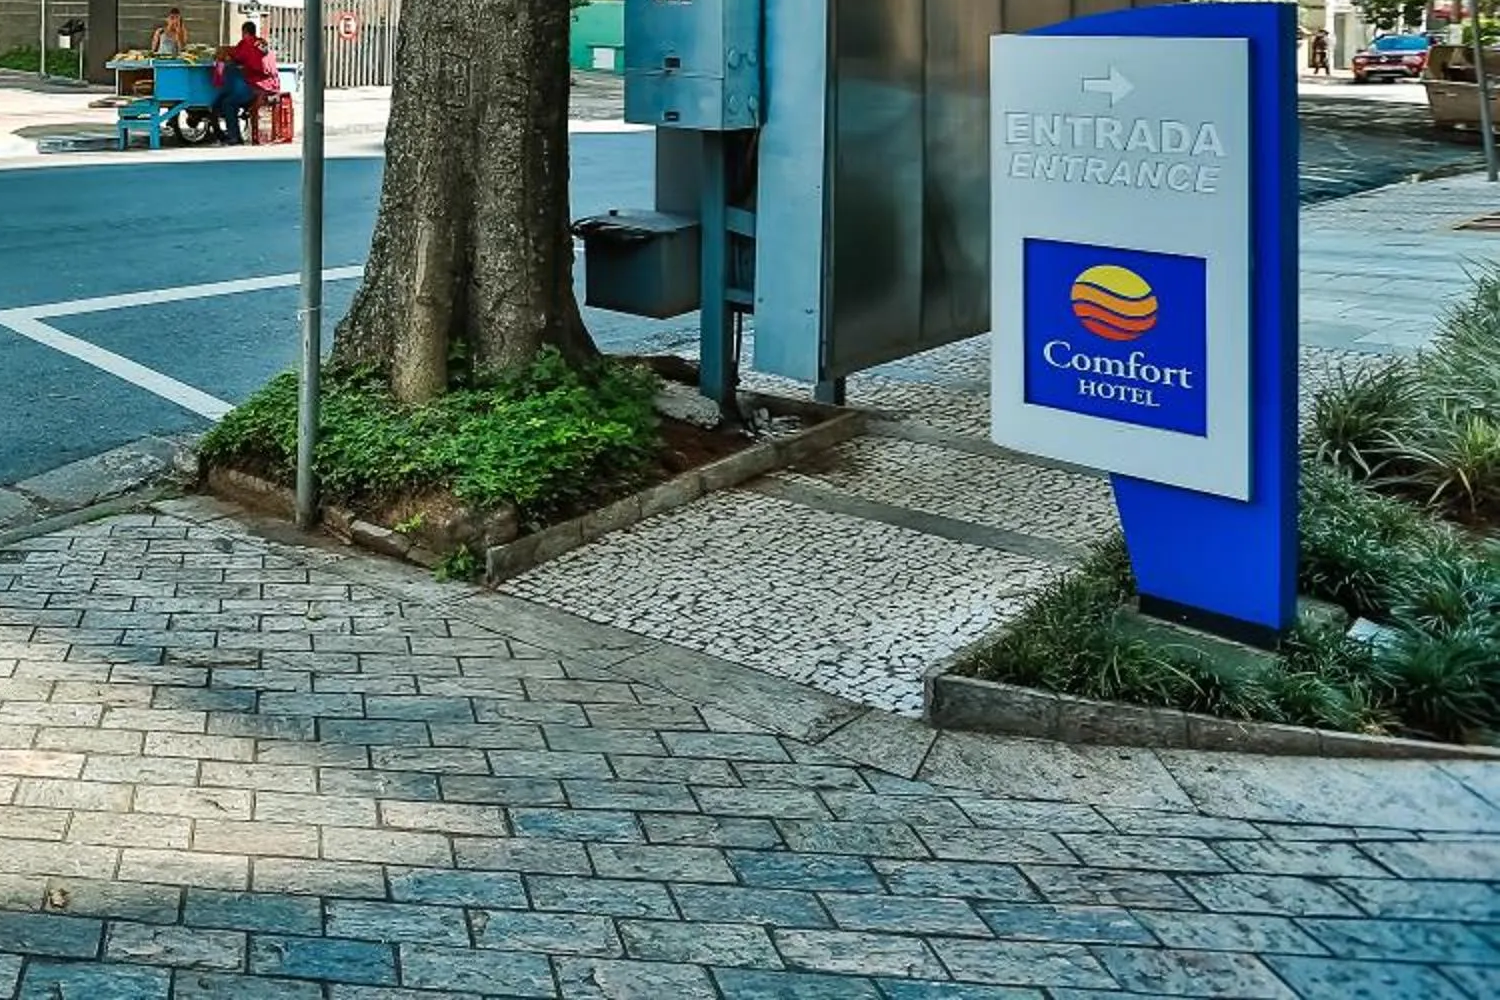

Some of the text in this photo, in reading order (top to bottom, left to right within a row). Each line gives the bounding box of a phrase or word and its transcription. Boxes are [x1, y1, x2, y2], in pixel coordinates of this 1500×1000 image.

[1004, 111, 1226, 157] ENTRADA
[1008, 152, 1221, 193] ENTRANCE
[1043, 339, 1193, 389] Comfort
[1077, 377, 1161, 407] HOTEL
